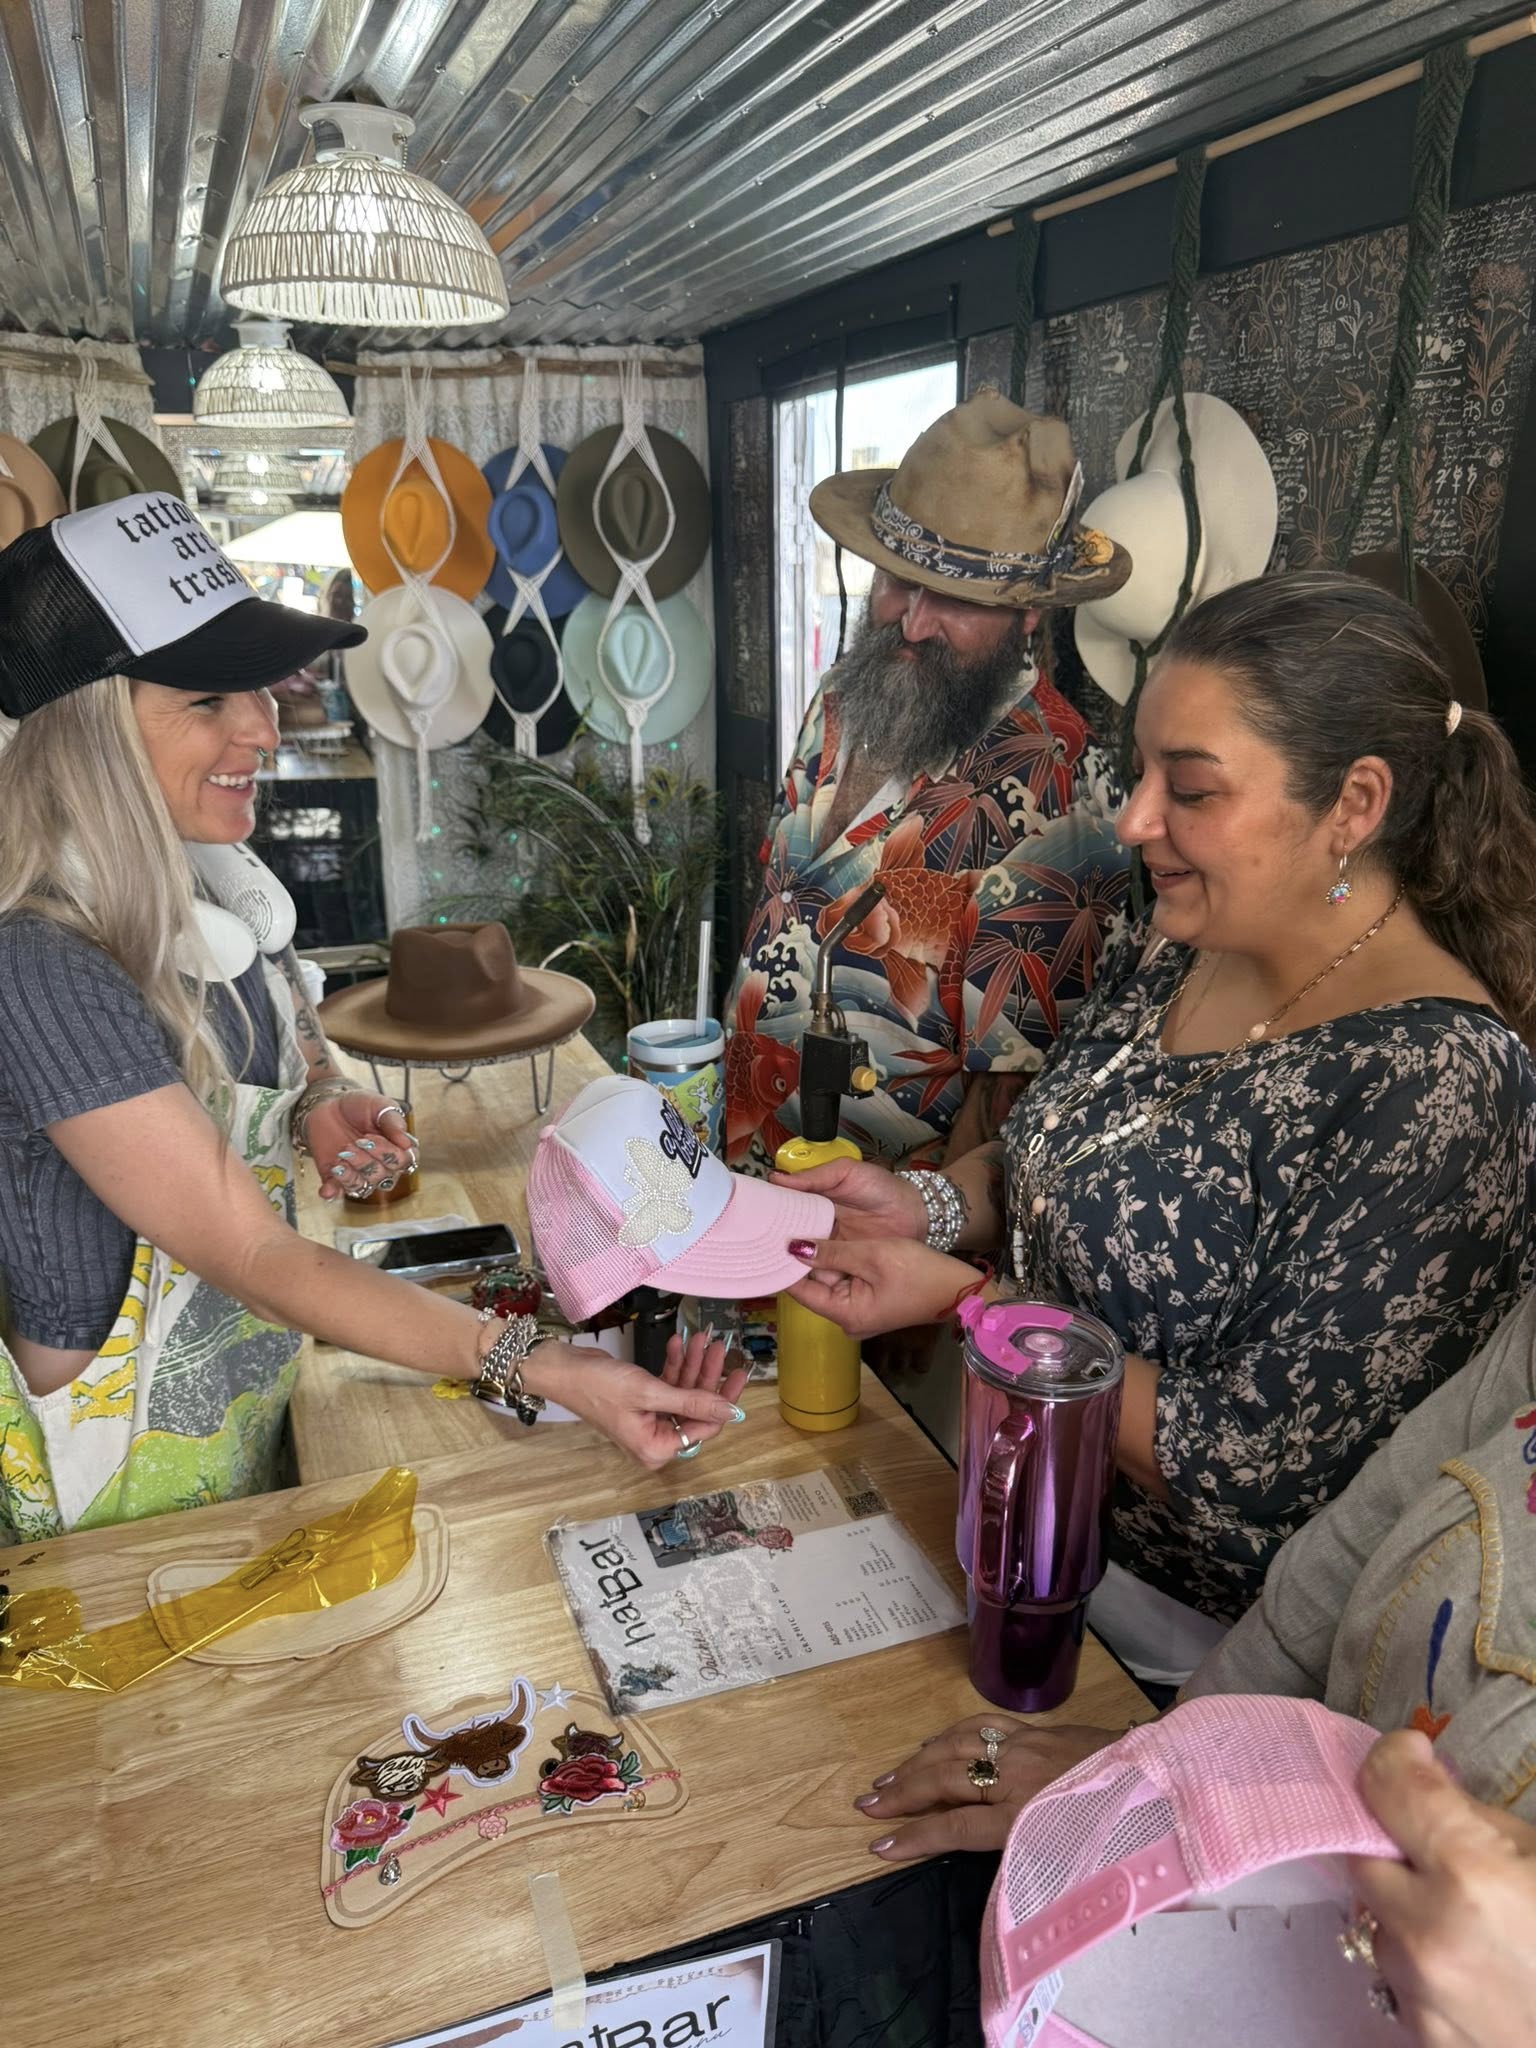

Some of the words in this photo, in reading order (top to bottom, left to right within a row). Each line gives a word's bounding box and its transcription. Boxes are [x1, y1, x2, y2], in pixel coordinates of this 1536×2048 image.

[171, 531, 217, 560] are
[579, 1537, 656, 1649] hatBar
[788, 1618, 812, 1652] GRAPHIC
[822, 1621, 841, 1645] Add-ons
[686, 1626, 728, 1683] Patched
